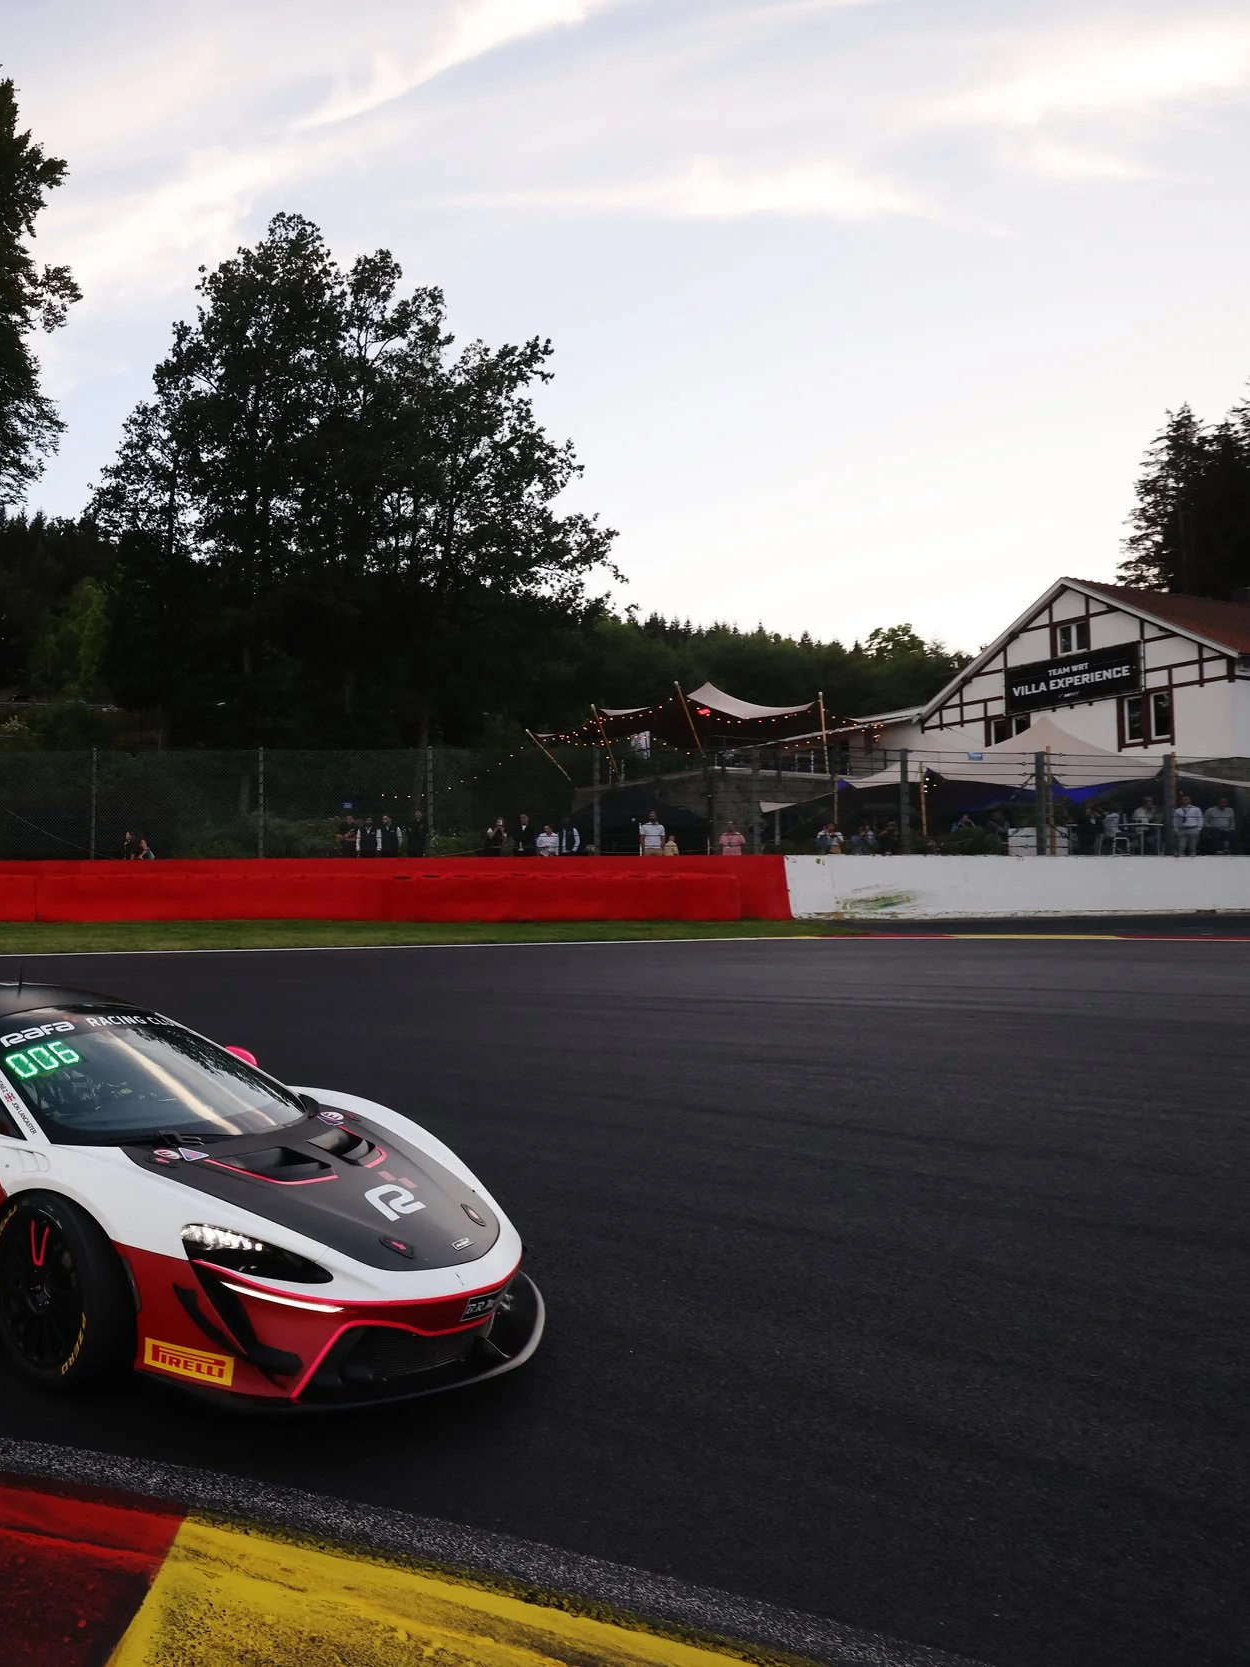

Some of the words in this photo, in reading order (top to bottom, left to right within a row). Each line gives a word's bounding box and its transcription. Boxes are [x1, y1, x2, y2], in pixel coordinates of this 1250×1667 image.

[1012, 682, 1047, 697] VILLA
[1048, 666, 1131, 691] EXPERIENCE
[1047, 667, 1070, 676] TEAM
[1071, 662, 1089, 672] WRT
[85, 1014, 148, 1027] RACING
[5, 1041, 80, 1079] 006
[17, 1109, 37, 1135] LANCASTER
[152, 1344, 226, 1374] PIRELLI
